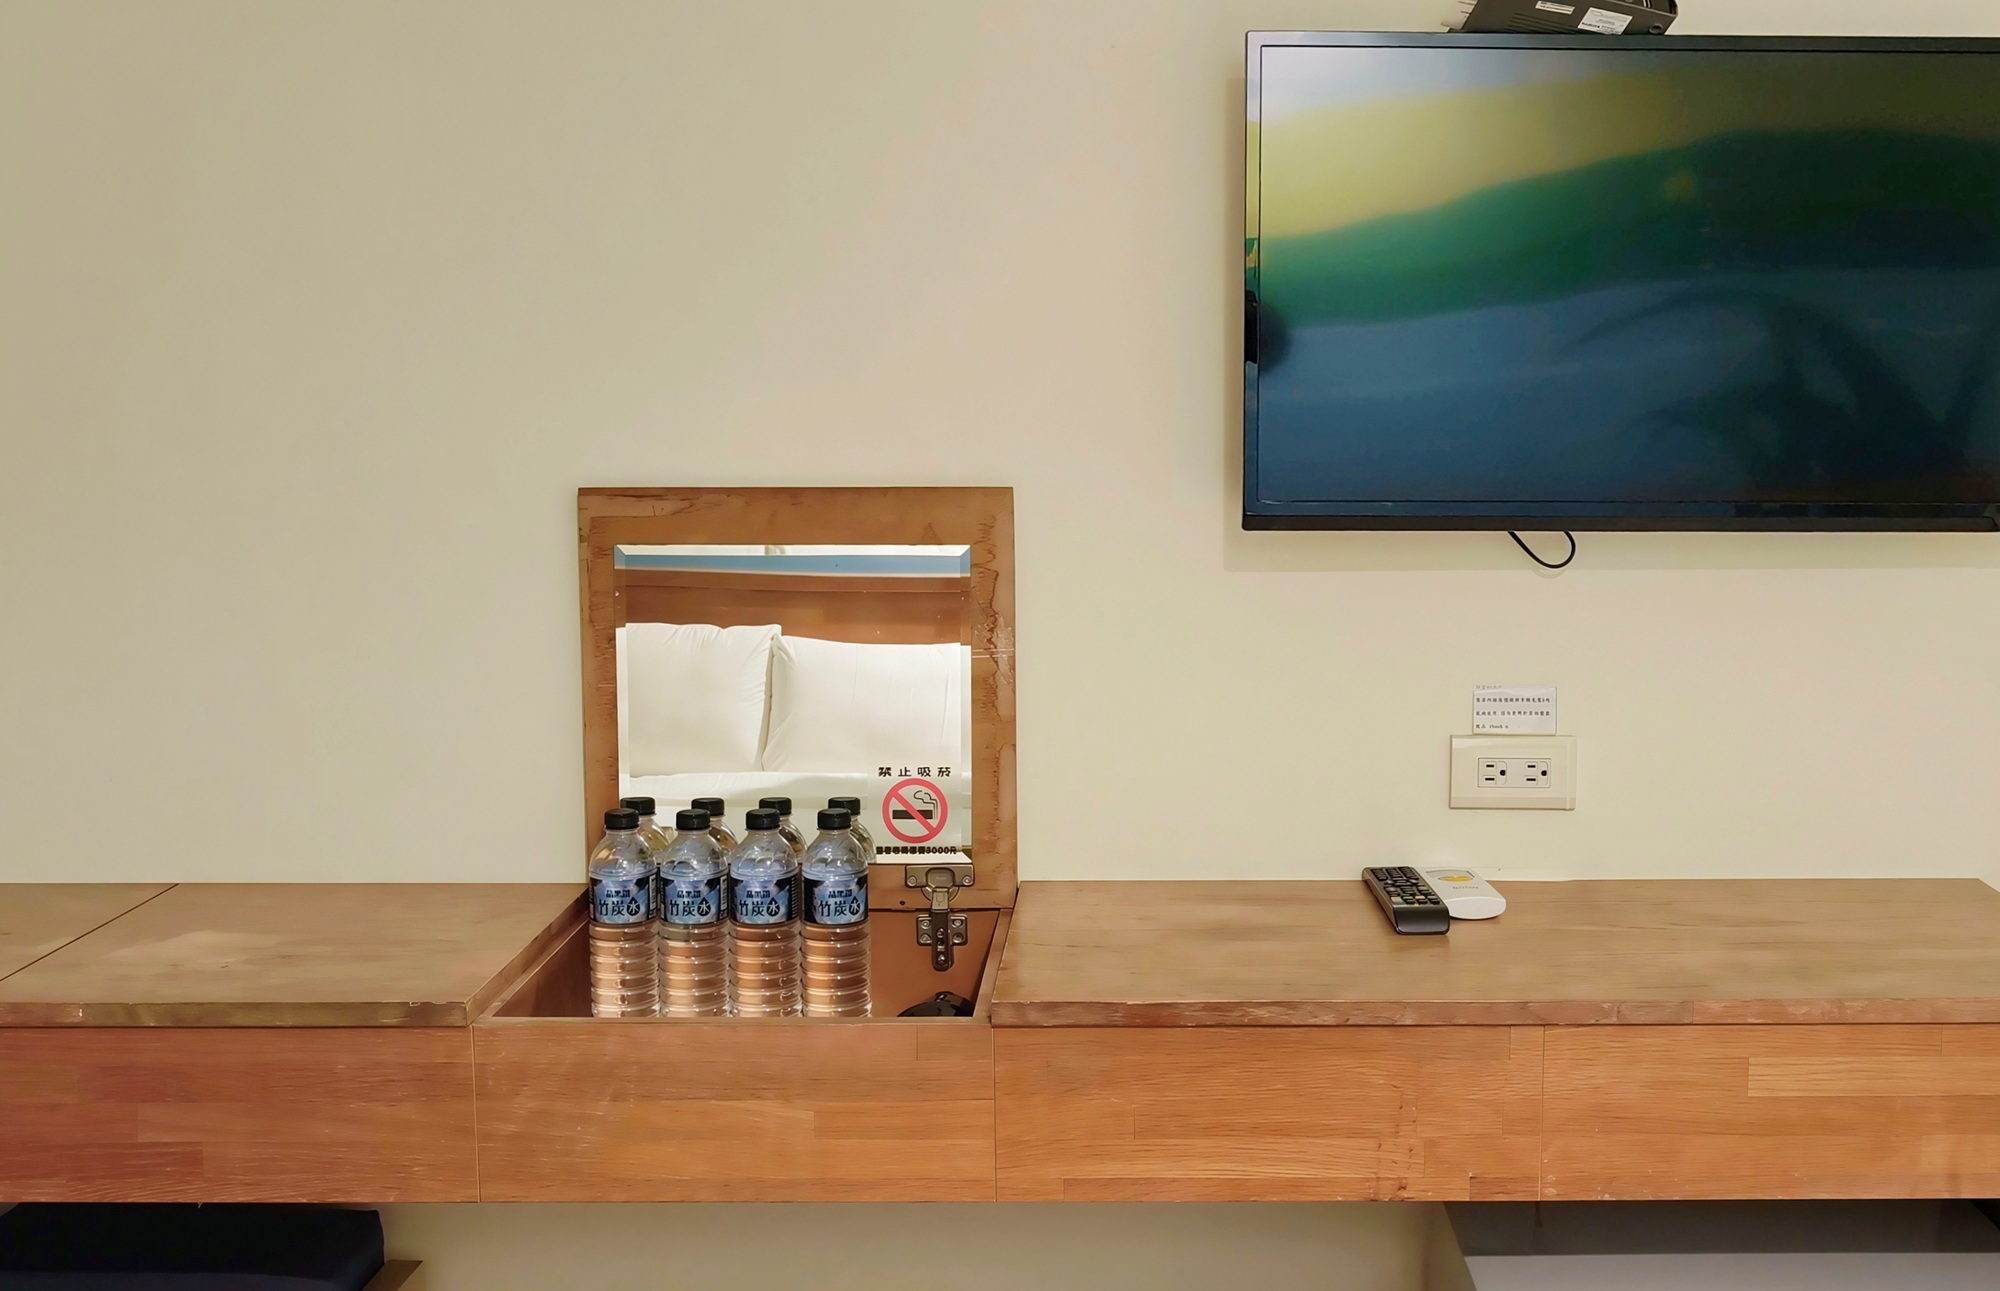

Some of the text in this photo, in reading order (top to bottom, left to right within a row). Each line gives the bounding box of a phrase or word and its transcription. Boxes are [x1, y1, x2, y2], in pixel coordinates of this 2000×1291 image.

[878, 766, 951, 777] 禁止吸菸
[599, 899, 640, 916] 竹炭水
[670, 899, 711, 916] 竹炭水
[739, 899, 780, 916] 竹炭水
[818, 900, 860, 916] 竹炭水
